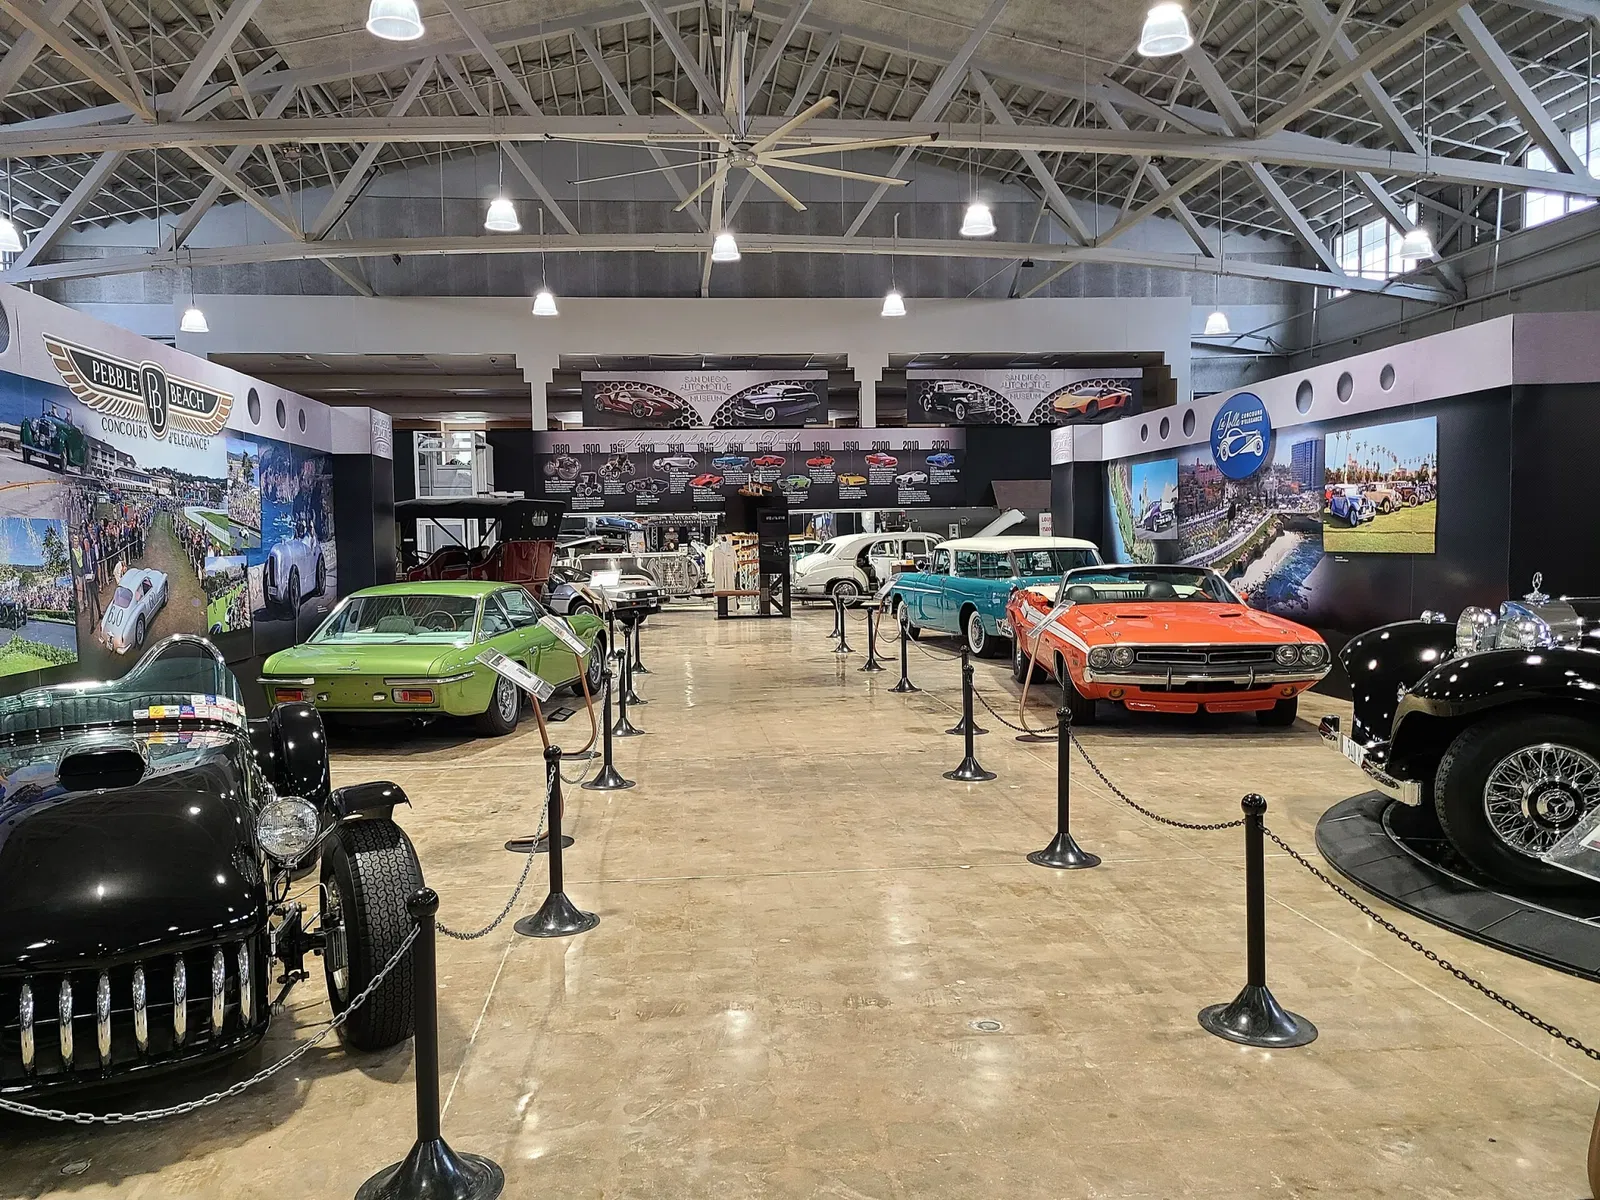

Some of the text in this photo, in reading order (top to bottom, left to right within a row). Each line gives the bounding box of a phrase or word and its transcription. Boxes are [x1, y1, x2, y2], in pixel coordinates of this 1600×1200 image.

[701, 375, 728, 383] DIEGO
[92, 360, 206, 412] PEBBLE BEACH
[680, 383, 732, 391] AUTOMOTIVE
[1241, 409, 1263, 419] CONCOURS
[101, 416, 148, 440] CONCOURS
[552, 443, 570, 454] 1880
[582, 443, 601, 454] 1900
[638, 443, 655, 453] 1920
[667, 443, 684, 453] 1930
[697, 442, 714, 452] 1940
[727, 442, 743, 452] 1950
[756, 442, 773, 452] 1960
[785, 442, 801, 452] 1970
[813, 441, 830, 451] 1980
[842, 441, 859, 451] 1990
[871, 440, 891, 451] 2000
[902, 440, 920, 450] 2010
[931, 440, 950, 450] 2020
